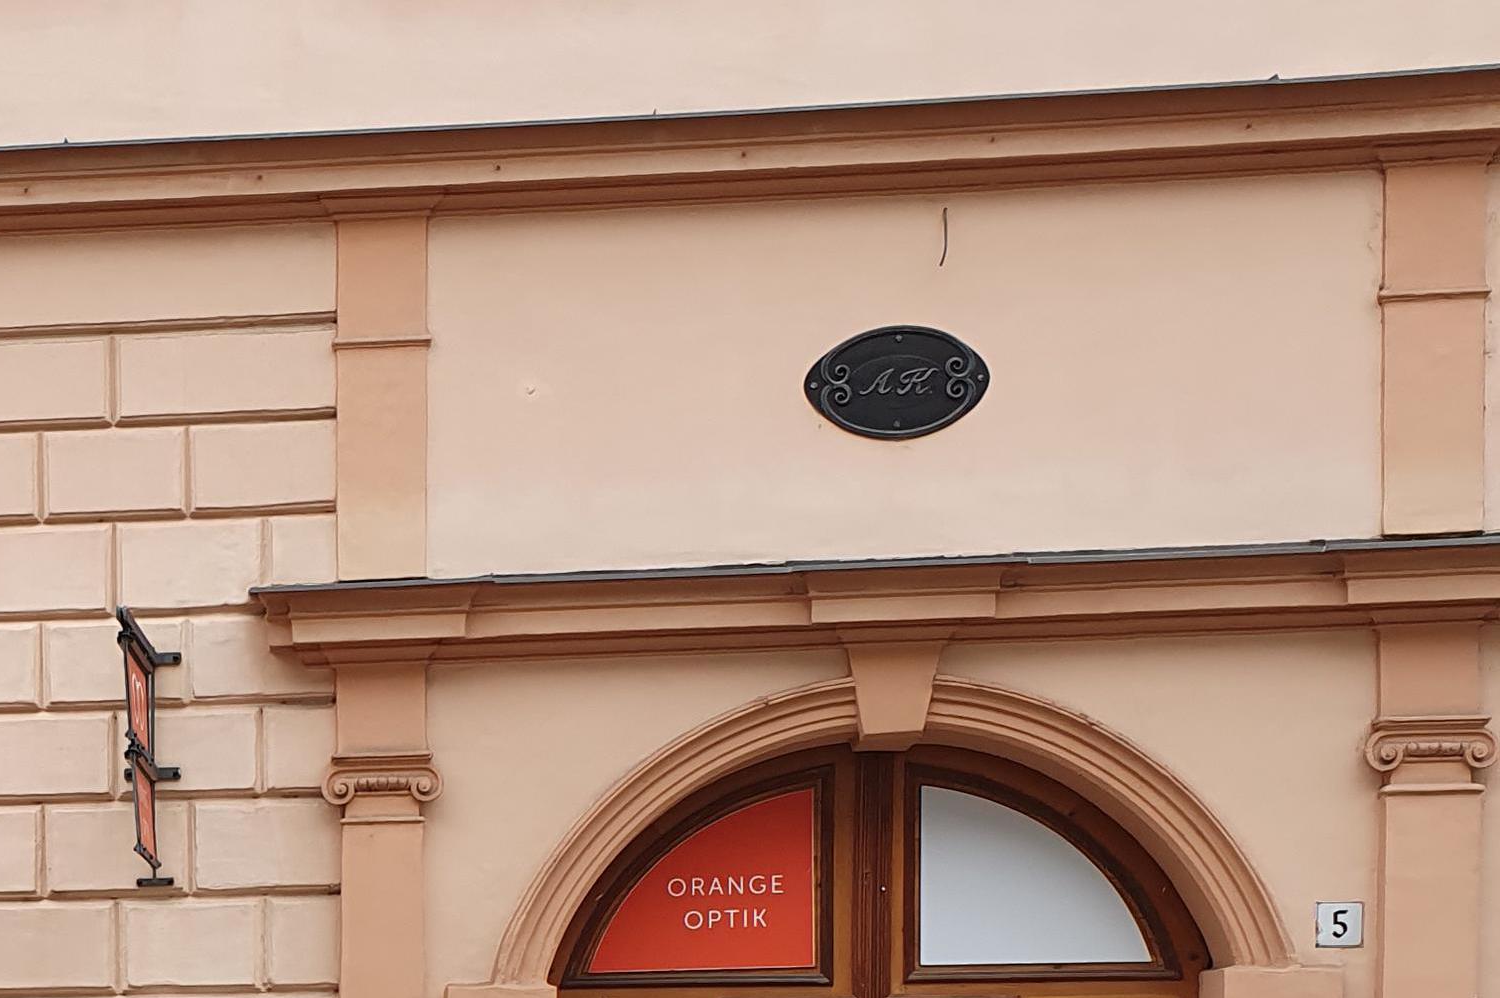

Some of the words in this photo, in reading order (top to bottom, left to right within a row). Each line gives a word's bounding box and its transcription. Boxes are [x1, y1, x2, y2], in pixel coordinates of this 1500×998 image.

[667, 874, 785, 897] ORANGE
[684, 908, 767, 930] OPTIK
[1332, 909, 1348, 938] 5
